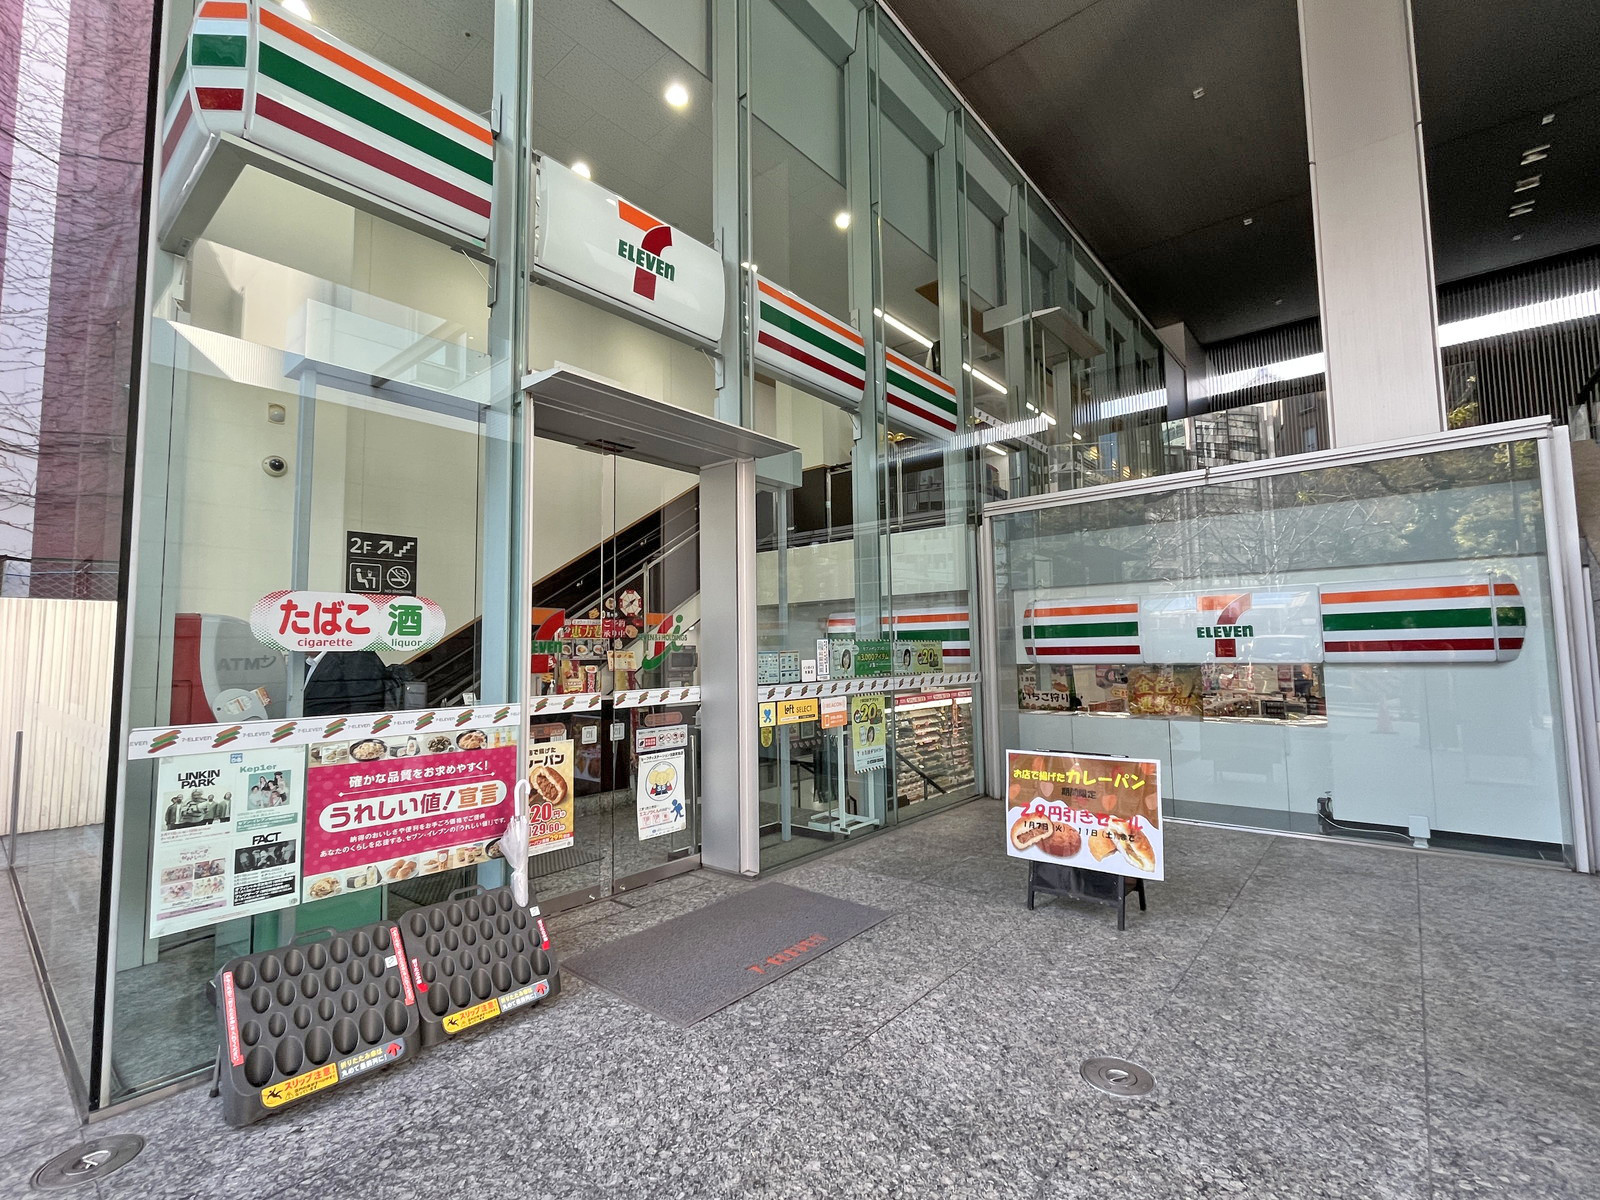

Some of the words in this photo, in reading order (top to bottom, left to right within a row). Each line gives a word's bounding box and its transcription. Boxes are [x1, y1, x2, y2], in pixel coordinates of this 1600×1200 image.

[349, 537, 373, 554] 2F
[278, 599, 371, 637] たばこ
[387, 603, 424, 637] 酒
[297, 637, 354, 649] cigarette
[390, 638, 424, 649] liquor
[217, 657, 260, 671] ATM
[177, 769, 221, 782] LINKIN
[1012, 768, 1147, 791] お店で揚げたカレーパン
[181, 778, 216, 790] PARK
[1060, 786, 1098, 800] 期間限定
[252, 831, 282, 846] FACT
[284, 1064, 337, 1091] スリップ注意!
